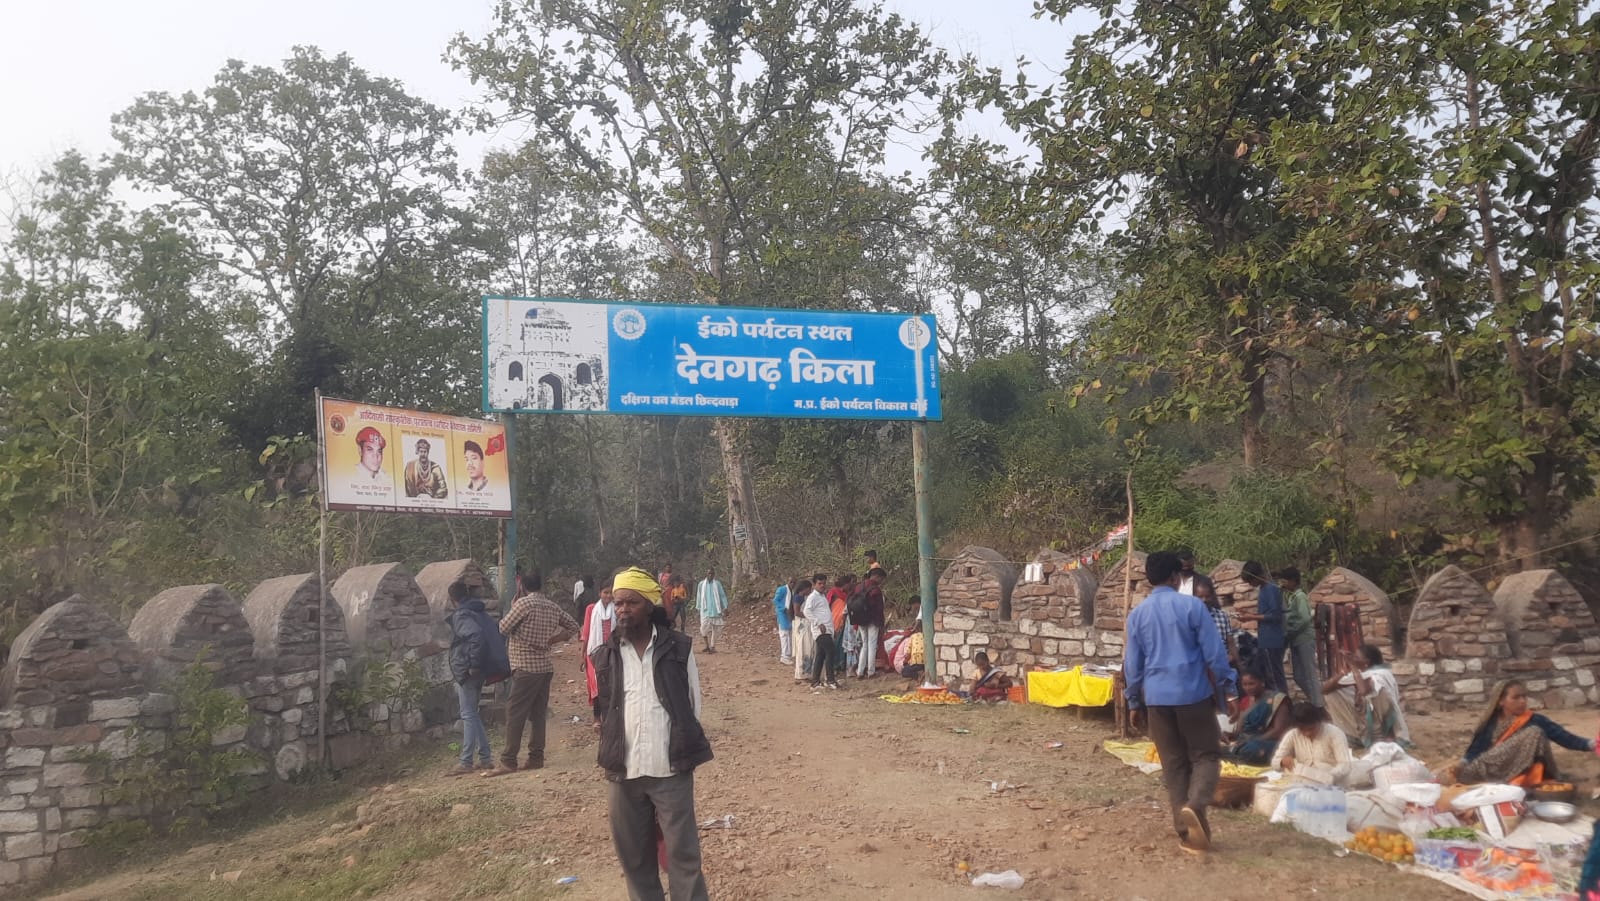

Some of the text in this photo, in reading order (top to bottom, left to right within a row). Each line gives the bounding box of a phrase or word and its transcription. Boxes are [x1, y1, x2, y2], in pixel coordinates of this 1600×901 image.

[697, 315, 852, 341] ईको पर्यटन स्थल
[675, 343, 875, 390] देवगढ़ किला
[621, 392, 650, 406] दक्षिण
[652, 395, 668, 406] वन
[794, 399, 817, 410] म.प्र.
[820, 396, 840, 410] ईको
[842, 398, 873, 410] पर्यटन
[875, 398, 908, 411] विकास
